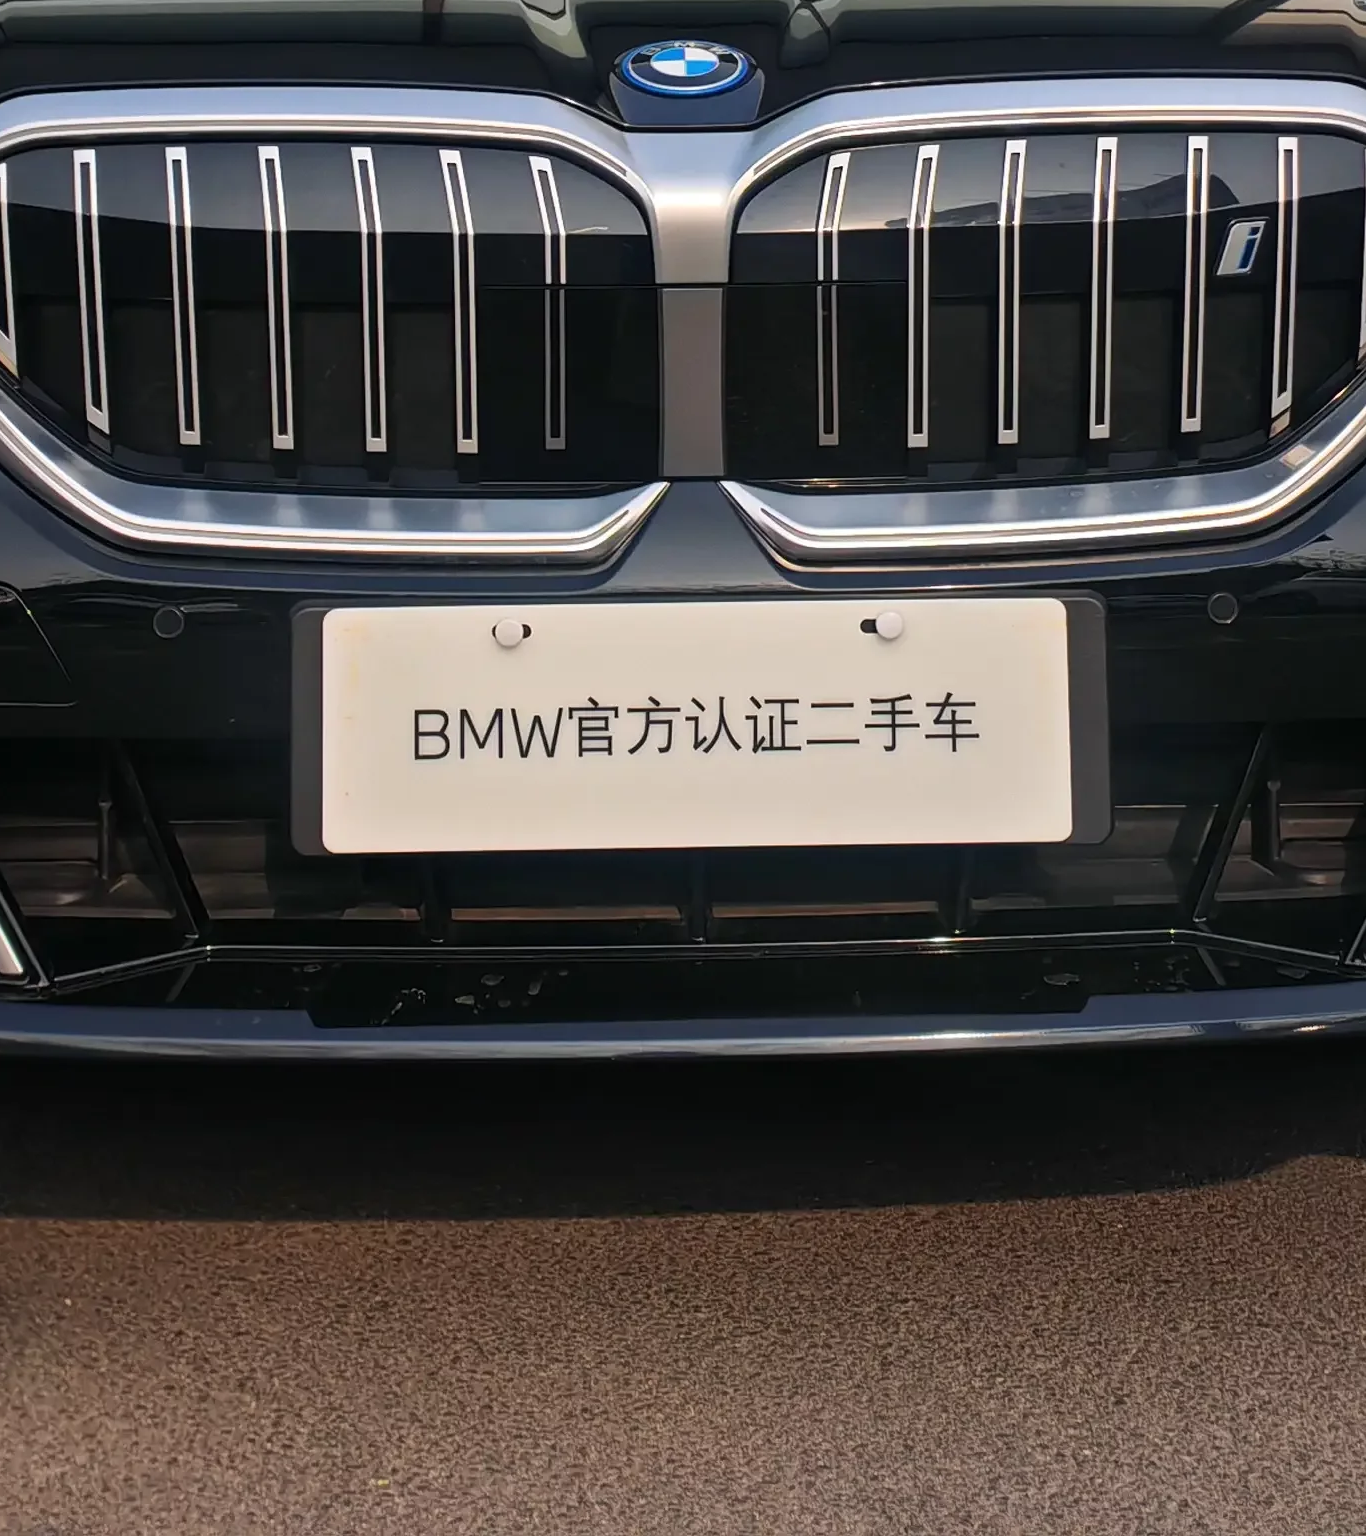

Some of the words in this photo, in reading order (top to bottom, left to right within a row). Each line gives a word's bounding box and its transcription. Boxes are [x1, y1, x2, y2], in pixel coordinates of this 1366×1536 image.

[412, 690, 982, 761] BMW官方认证二手车
